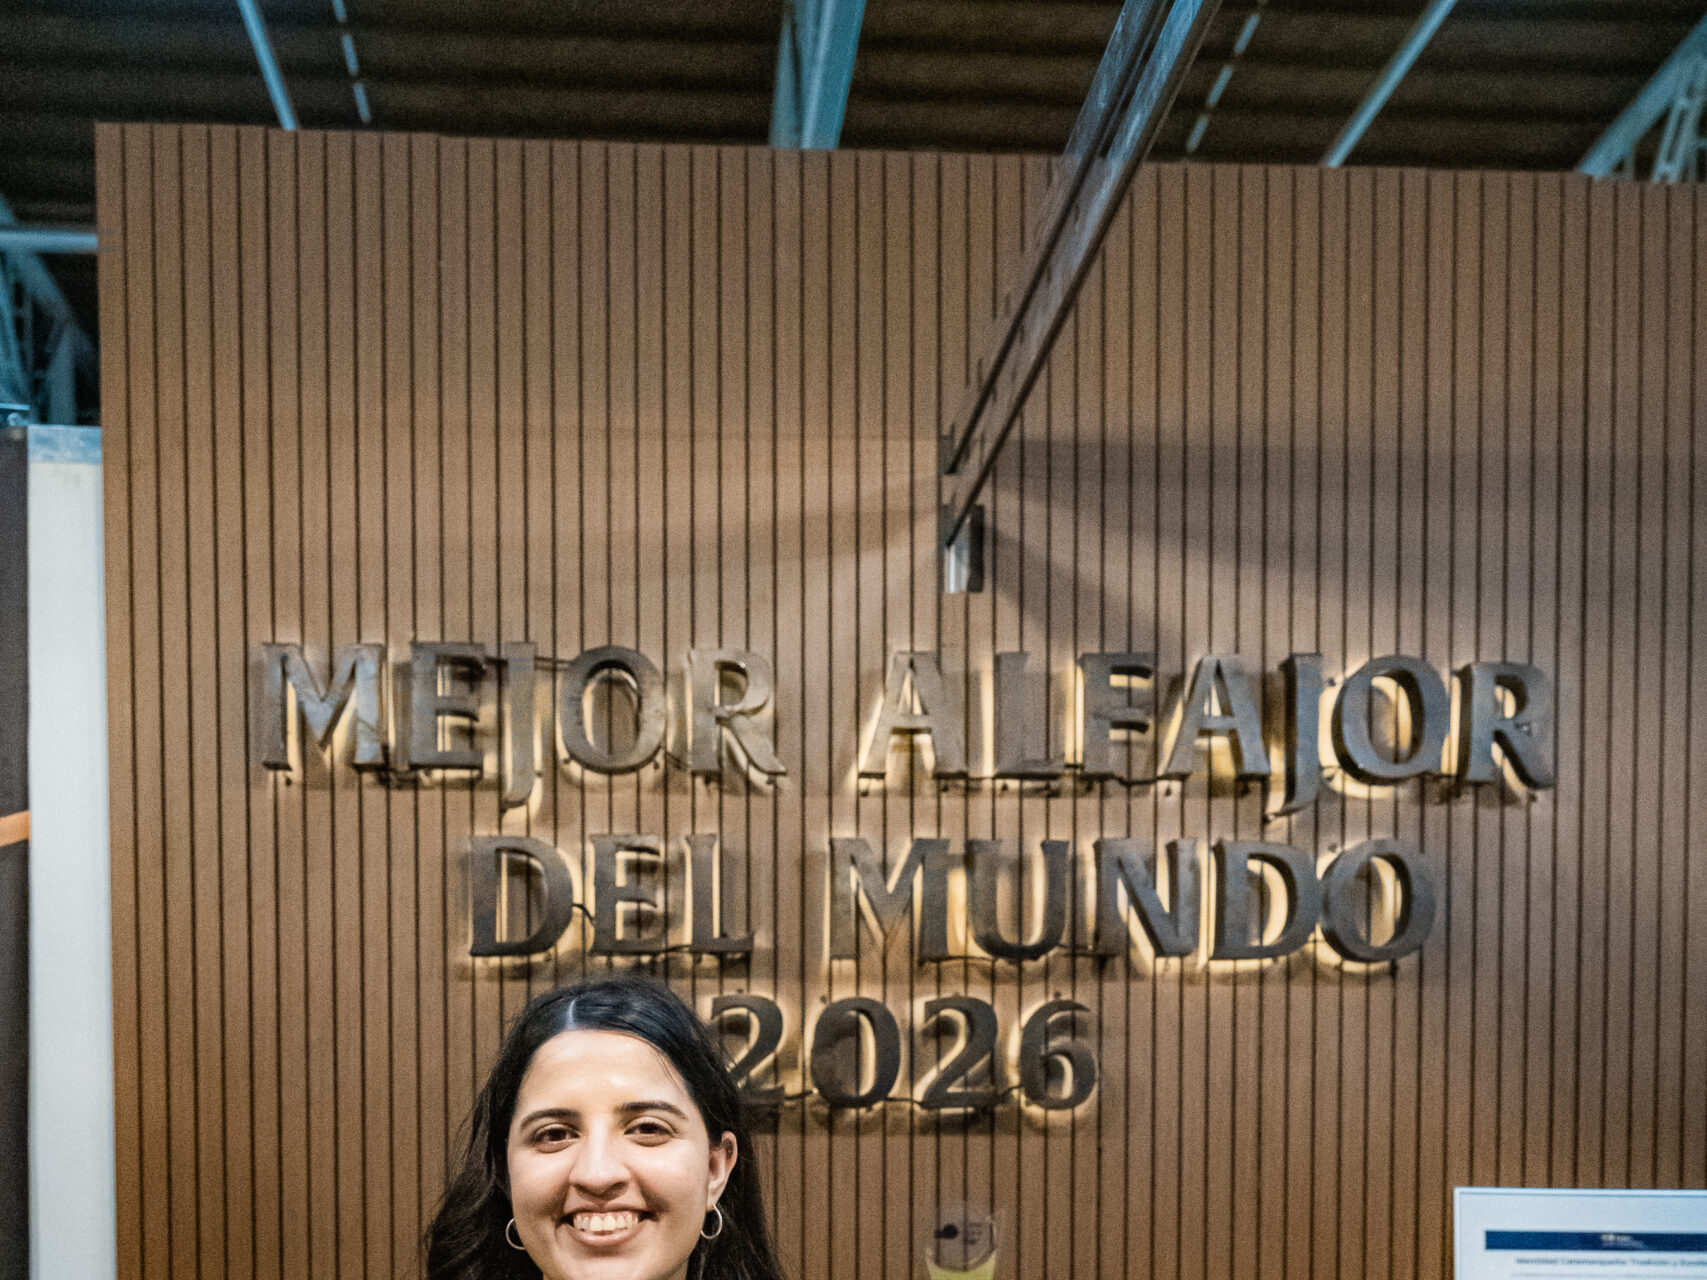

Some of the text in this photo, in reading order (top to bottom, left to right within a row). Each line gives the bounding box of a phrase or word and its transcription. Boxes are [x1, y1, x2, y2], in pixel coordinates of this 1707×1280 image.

[261, 641, 1557, 820] MEJOR ALFAJOR
[468, 834, 1438, 962] DEL MUNDO
[711, 993, 1097, 1111] 2026
